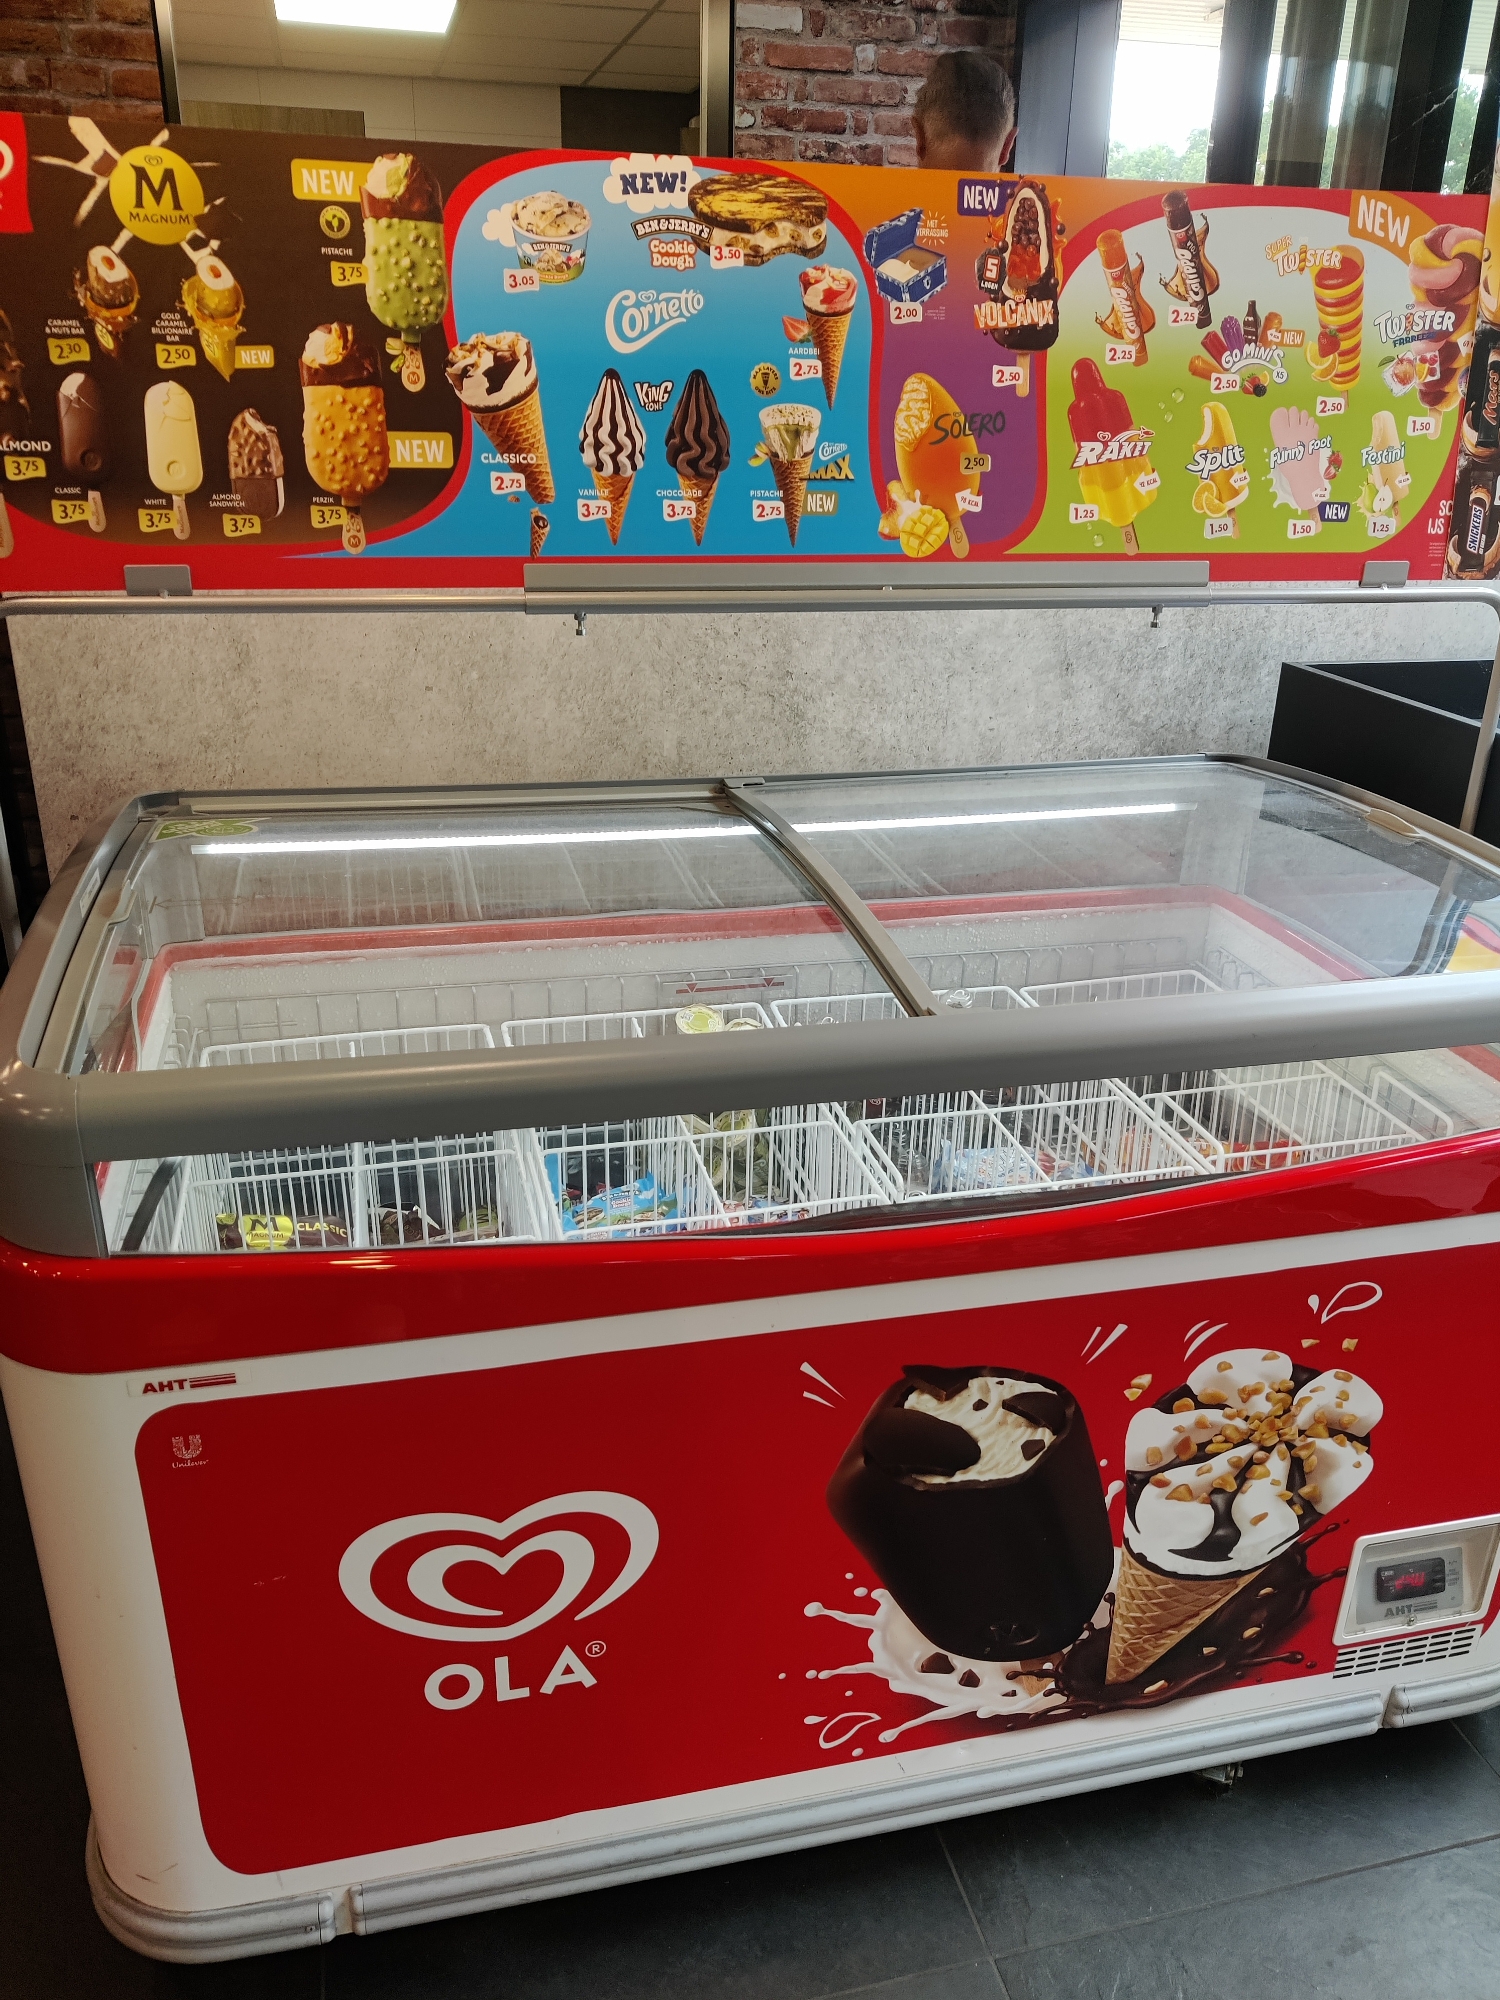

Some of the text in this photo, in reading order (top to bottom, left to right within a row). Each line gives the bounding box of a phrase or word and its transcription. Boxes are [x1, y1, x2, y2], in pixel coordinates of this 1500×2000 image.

[301, 168, 354, 195] NEW
[620, 171, 687, 195] NEW!
[963, 185, 999, 211] NEW
[129, 211, 190, 225] MAGNUM
[927, 220, 938, 228] MET
[1357, 196, 1410, 247] NEW
[916, 228, 949, 238] VERRASSING
[321, 247, 353, 256] PISTACHE
[650, 240, 696, 255] Cookie
[714, 246, 741, 260] 3.50
[1265, 235, 1292, 260] SUPER
[652, 254, 694, 271] Dough
[986, 257, 999, 279] 5
[337, 266, 363, 282] 3.75
[509, 274, 534, 288] 3.05
[1175, 248, 1205, 302] Calippo
[161, 312, 181, 320] GOLD
[893, 306, 918, 320] 2.00
[974, 298, 1054, 328] VOLCANIX
[1111, 287, 1141, 339] Calippo
[1171, 309, 1195, 323] 2.25
[47, 319, 81, 327] CARAMEL
[155, 320, 187, 328] CARAMEL
[604, 289, 705, 354] Cornetto
[71, 327, 86, 335] BAR
[151, 327, 193, 336] BILLIONAIRE
[1283, 332, 1303, 345] NEW
[54, 343, 81, 359] 2.30
[162, 348, 190, 364] 2.50
[241, 350, 270, 364] NEW
[788, 347, 820, 355] AARDBEI
[1108, 347, 1133, 361] 2.25
[1222, 349, 1241, 367] GO
[793, 362, 818, 376] 2.75
[1275, 370, 1285, 379] X5
[995, 370, 1020, 383] 2.50
[1214, 377, 1238, 389] 2.50
[1482, 370, 1499, 425] Mars
[1319, 400, 1343, 413] 2.50
[929, 410, 1006, 446] SOLERO
[1412, 420, 1431, 432] 1.50
[395, 439, 444, 463] NEW
[1070, 441, 1153, 468] RAKET
[1269, 435, 1333, 469] Funny Foot
[1361, 442, 1406, 467] Festini
[481, 453, 537, 464] CLASSICO
[964, 457, 985, 470] 2.50
[1186, 443, 1245, 479] Split
[11, 460, 39, 477] 3.75
[494, 475, 522, 491] 2.75
[312, 496, 334, 504] PERZIK
[656, 489, 702, 497] CHOCOLADE
[209, 500, 245, 508] SANDWICH
[581, 503, 608, 517] 3.75
[666, 503, 693, 517] 3.75
[806, 494, 835, 512] NEW
[59, 503, 85, 520] 3.75
[317, 509, 342, 525] 3.75
[756, 503, 782, 518] 2.75
[1073, 507, 1095, 520] 1.25
[1325, 504, 1348, 519] NEW
[145, 512, 171, 528] 3.75
[229, 516, 255, 533] 3.75
[1427, 518, 1444, 534] IJS
[1209, 522, 1229, 534] 1.50
[1292, 523, 1312, 534] 1.50
[1372, 522, 1390, 533] 1.25
[1468, 507, 1483, 551] SNICKERS
[143, 1379, 187, 1394] AHT
[171, 1459, 208, 1468] Unilever
[1384, 1604, 1413, 1617] AHT
[424, 1644, 598, 1711] OLA
